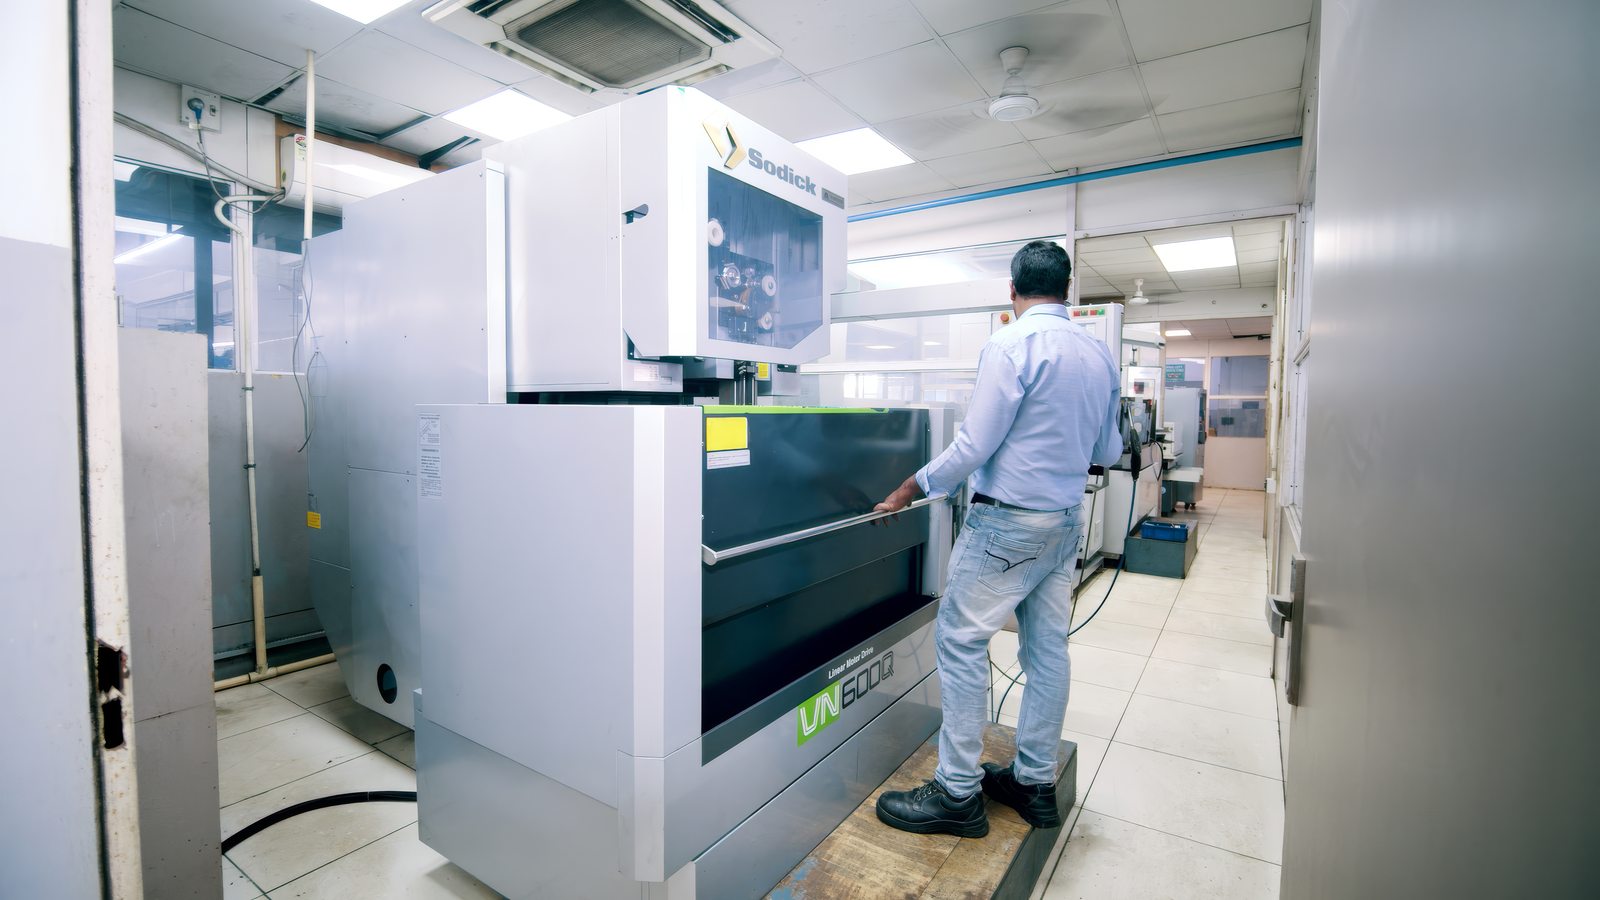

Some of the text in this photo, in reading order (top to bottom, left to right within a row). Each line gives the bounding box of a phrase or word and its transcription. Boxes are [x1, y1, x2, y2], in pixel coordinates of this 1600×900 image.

[748, 147, 816, 195] Sodick
[828, 646, 874, 679] Linear Motor Drive
